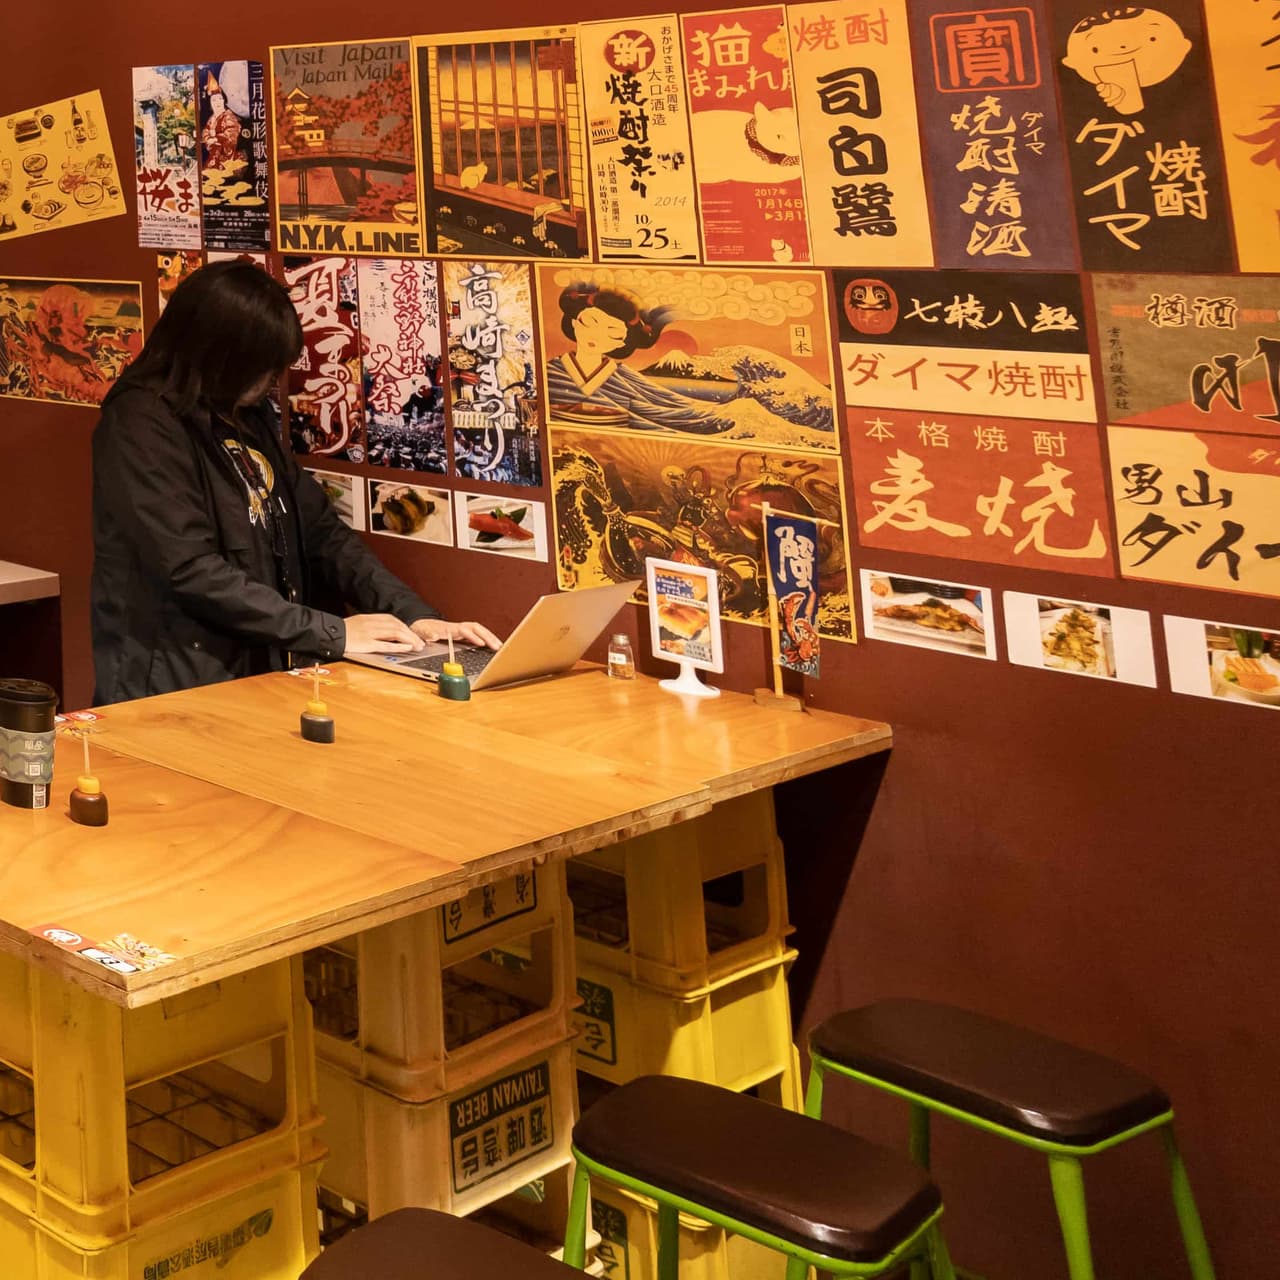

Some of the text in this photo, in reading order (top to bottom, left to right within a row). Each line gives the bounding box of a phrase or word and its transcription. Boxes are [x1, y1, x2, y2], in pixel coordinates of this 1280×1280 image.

[281, 42, 403, 66] Visit Japan
[607, 34, 651, 70] 新
[690, 22, 752, 67] 猫
[301, 67, 346, 85] Japan
[647, 68, 667, 127] 大口酒造
[250, 63, 269, 199] 三月花形歌舞伎
[605, 70, 656, 199] 焼酎祭り
[1021, 111, 1046, 155] ダイマ
[654, 196, 688, 207] 2014
[1076, 118, 1151, 250] ダイマ
[1146, 140, 1208, 220] 焼酎
[638, 227, 669, 249] 25
[793, 326, 812, 355] 日本
[459, 264, 511, 473] 高崎まつり
[847, 352, 1087, 402] ダイマ焼酎
[864, 417, 1068, 458] 本格焼酎
[1120, 462, 1232, 510] 男山
[456, 1065, 546, 1129] TAIWAN BEER
